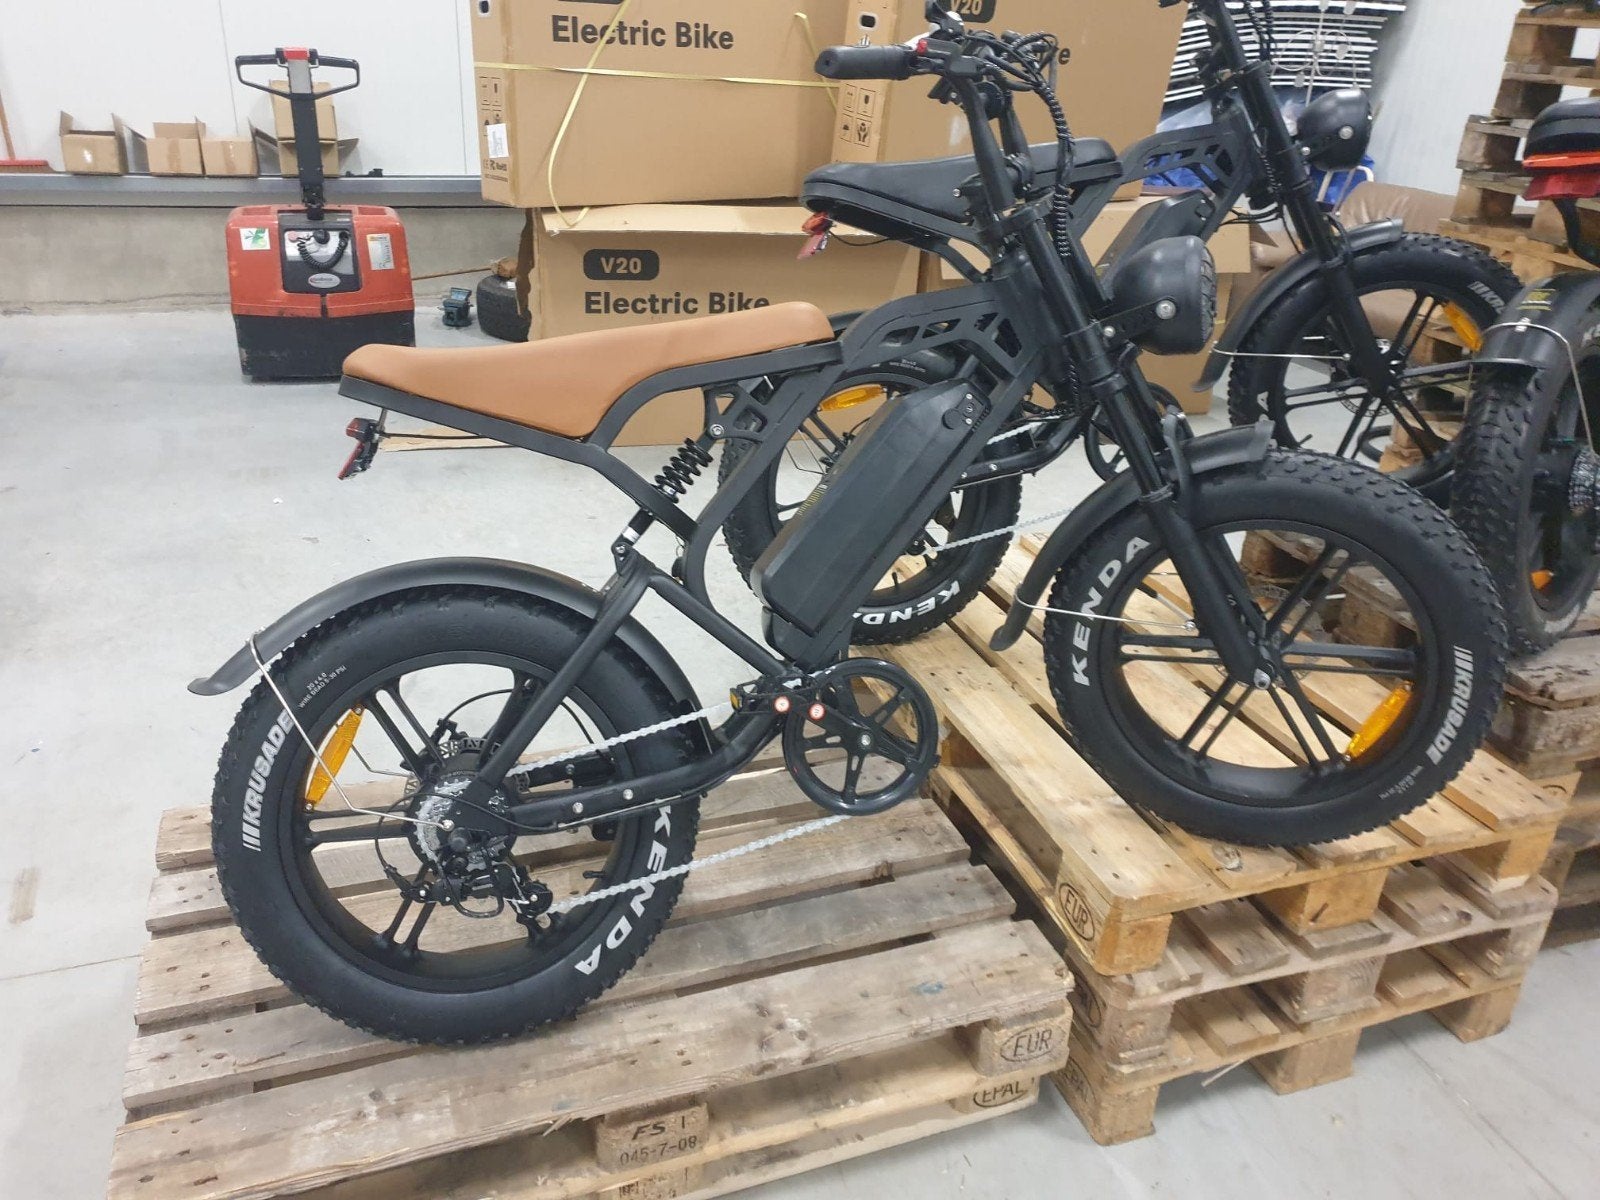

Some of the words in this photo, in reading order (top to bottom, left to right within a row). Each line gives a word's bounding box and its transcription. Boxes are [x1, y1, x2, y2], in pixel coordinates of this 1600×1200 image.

[552, 15, 666, 46] Electric
[676, 22, 734, 49] Bike
[601, 257, 642, 274] V20
[585, 292, 698, 315] Electric
[709, 292, 770, 315] Bike
[1071, 536, 1151, 686] KENDA
[242, 709, 295, 827] KRUSADE
[574, 804, 672, 976] KENDA
[1065, 889, 1088, 934] EUR
[1013, 1029, 1053, 1058] EUR
